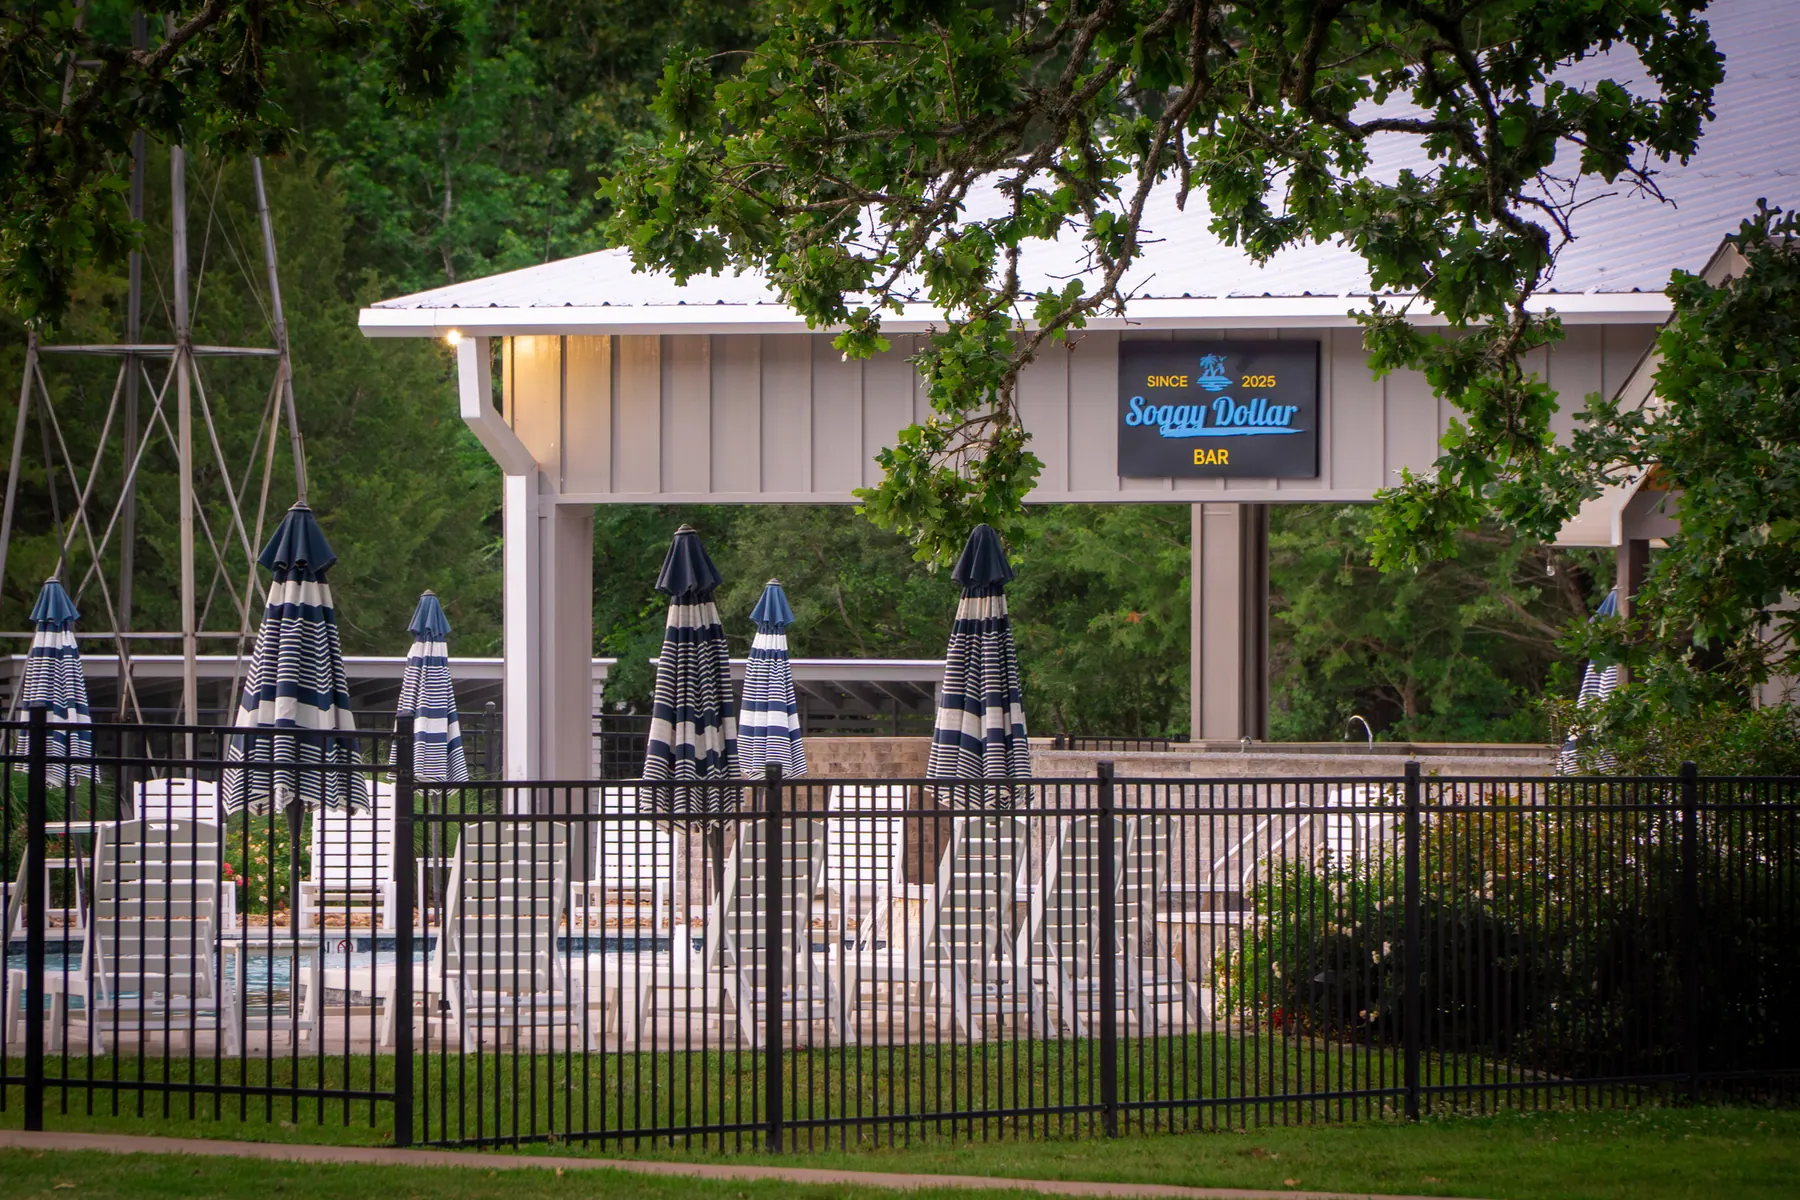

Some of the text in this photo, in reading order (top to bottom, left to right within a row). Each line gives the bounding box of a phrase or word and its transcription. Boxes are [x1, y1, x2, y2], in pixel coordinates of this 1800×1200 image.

[1147, 375, 1276, 388] SINCE 2025
[1125, 395, 1299, 435] Soggy Dollar
[1193, 448, 1229, 465] BAR
